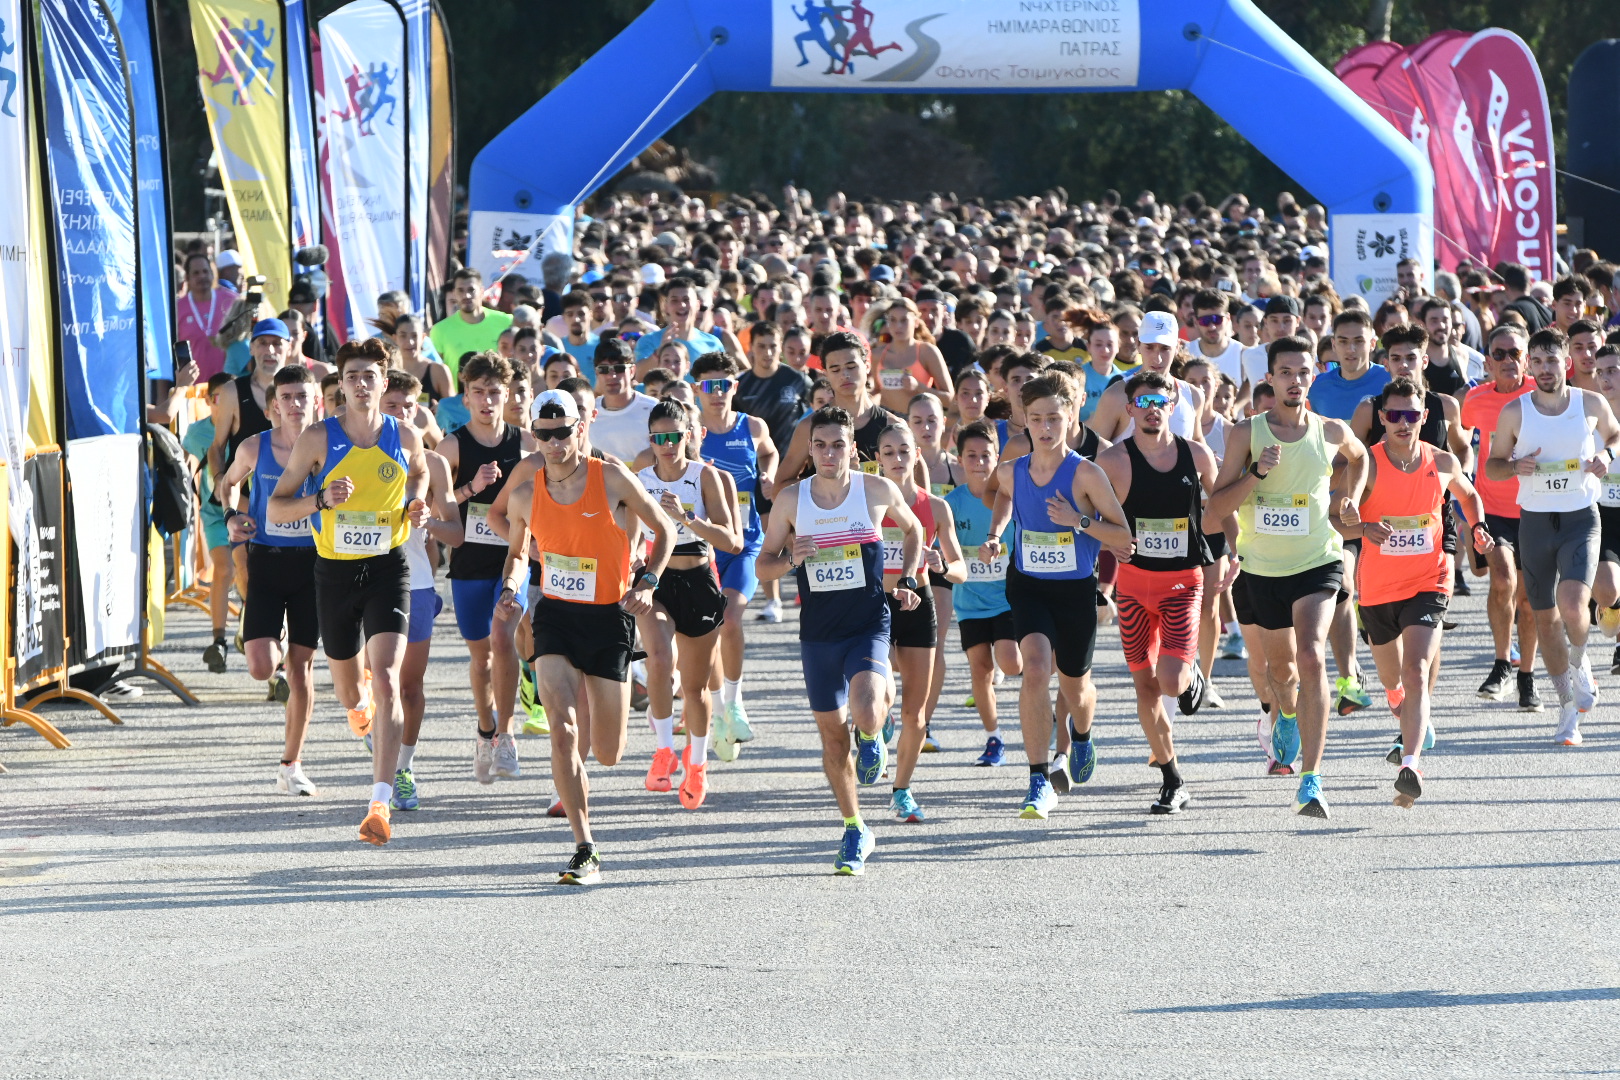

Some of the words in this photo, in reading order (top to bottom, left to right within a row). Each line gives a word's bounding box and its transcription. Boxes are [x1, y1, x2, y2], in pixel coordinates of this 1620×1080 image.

[987, 18, 1121, 34] ΗΜΙΜΑΡΑΘΩΝΙΟΣ
[1060, 41, 1121, 56] ΠΑΤΡΑΣ
[935, 65, 1001, 81] Φάνης
[1545, 478, 1569, 490] 167
[814, 515, 849, 525] saucony
[1263, 513, 1300, 527] 6296
[343, 531, 382, 546] 6207
[1144, 537, 1179, 550] 6310
[1389, 534, 1425, 548] 5545
[1030, 550, 1066, 564] 6453
[815, 565, 855, 583] 6425
[970, 561, 1002, 574] 6315
[551, 573, 585, 591] 6426
